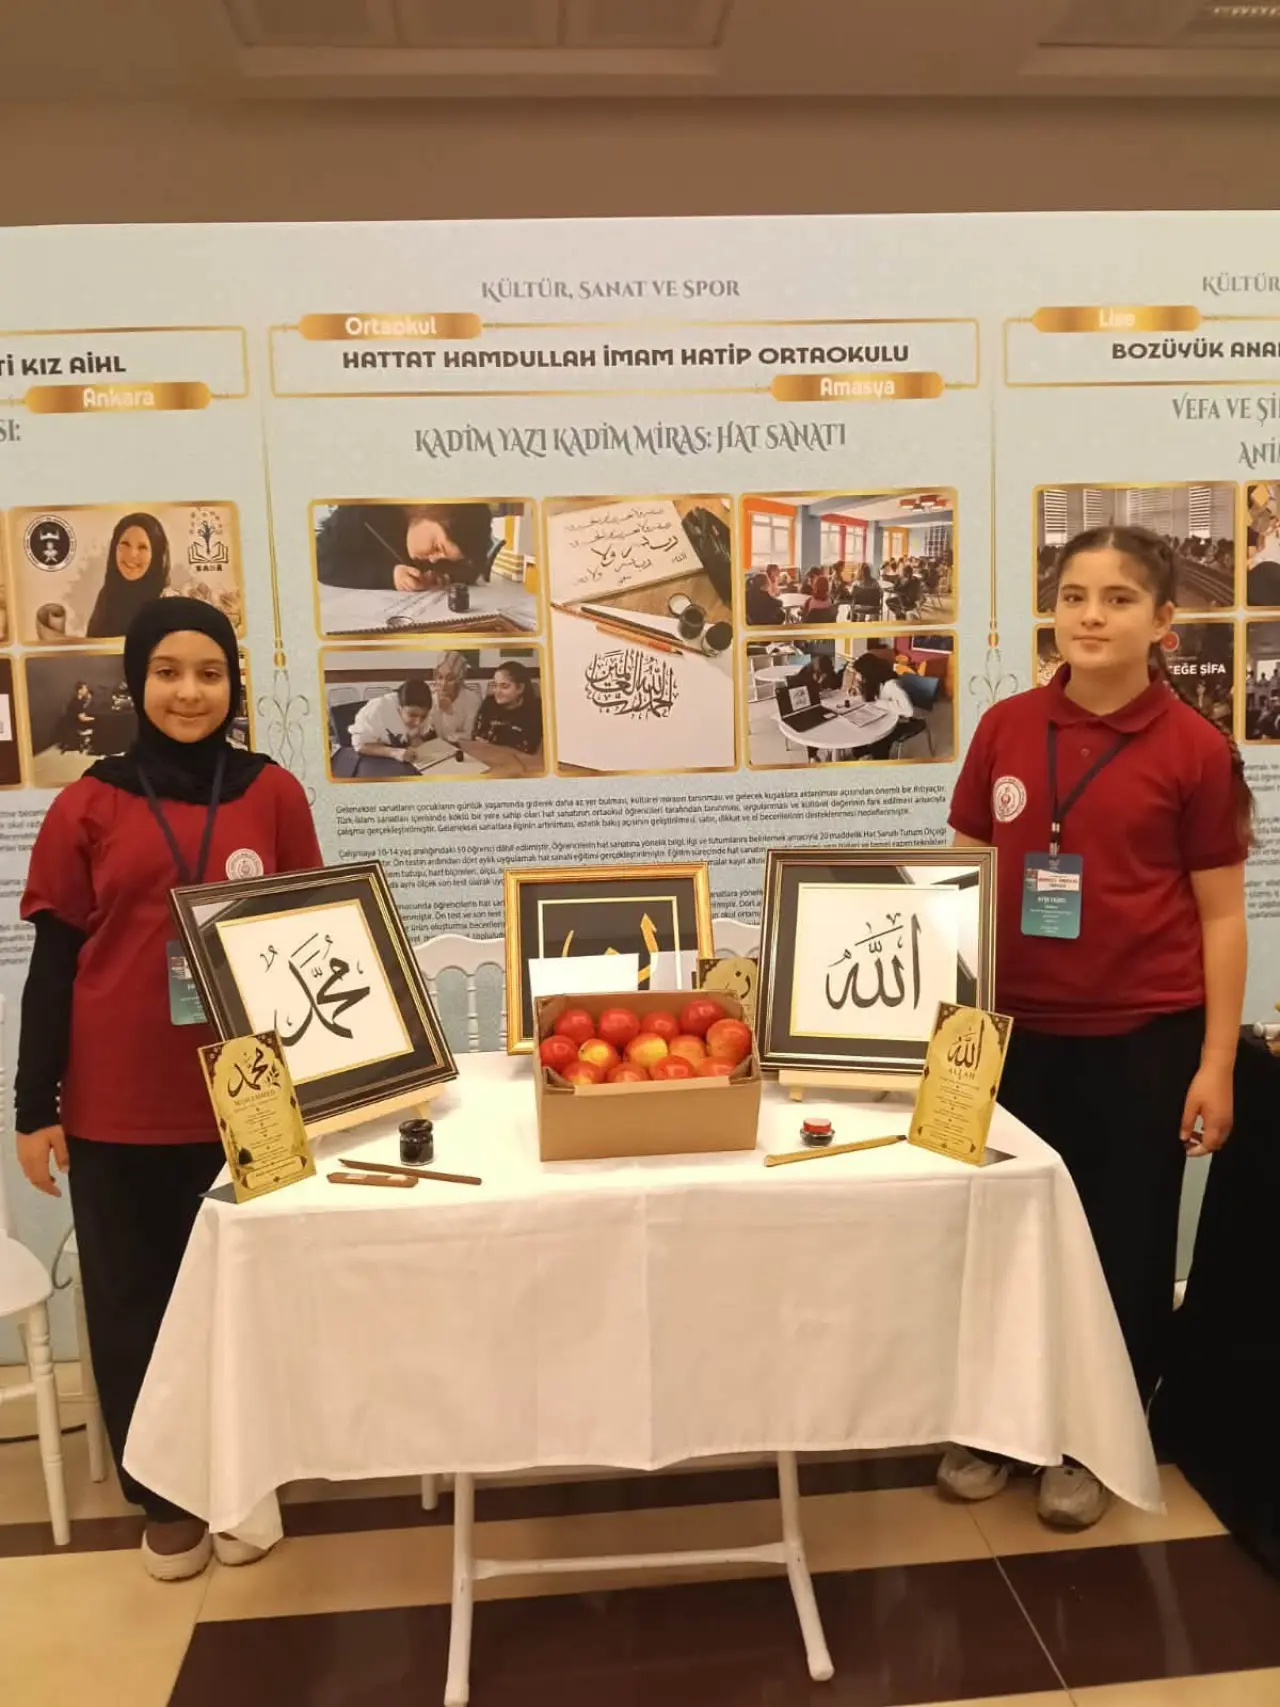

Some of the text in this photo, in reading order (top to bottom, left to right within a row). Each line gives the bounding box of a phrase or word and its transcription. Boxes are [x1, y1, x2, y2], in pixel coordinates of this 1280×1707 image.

[481, 277, 741, 302] KÜLTÜR, SANAT VE SPOR
[344, 314, 438, 337] Ortaokul
[1099, 308, 1136, 327] Lise
[342, 342, 910, 369] HATTAT HAMDULLAH İMAM HATİP ORTAOKULU
[1112, 338, 1224, 360] BOZÜYÜK
[21, 357, 63, 376] KIZ
[69, 351, 127, 375] AİHL
[82, 384, 155, 409] Ankara
[820, 376, 896, 397] Amasya
[1226, 397, 1251, 419] VE
[1257, 392, 1280, 428] Şİ
[414, 420, 846, 459] KADİM YAZI KADİM MİRAS: HAT SANATI
[1238, 436, 1280, 471] ANİ
[1200, 661, 1227, 677] ŞİFA
